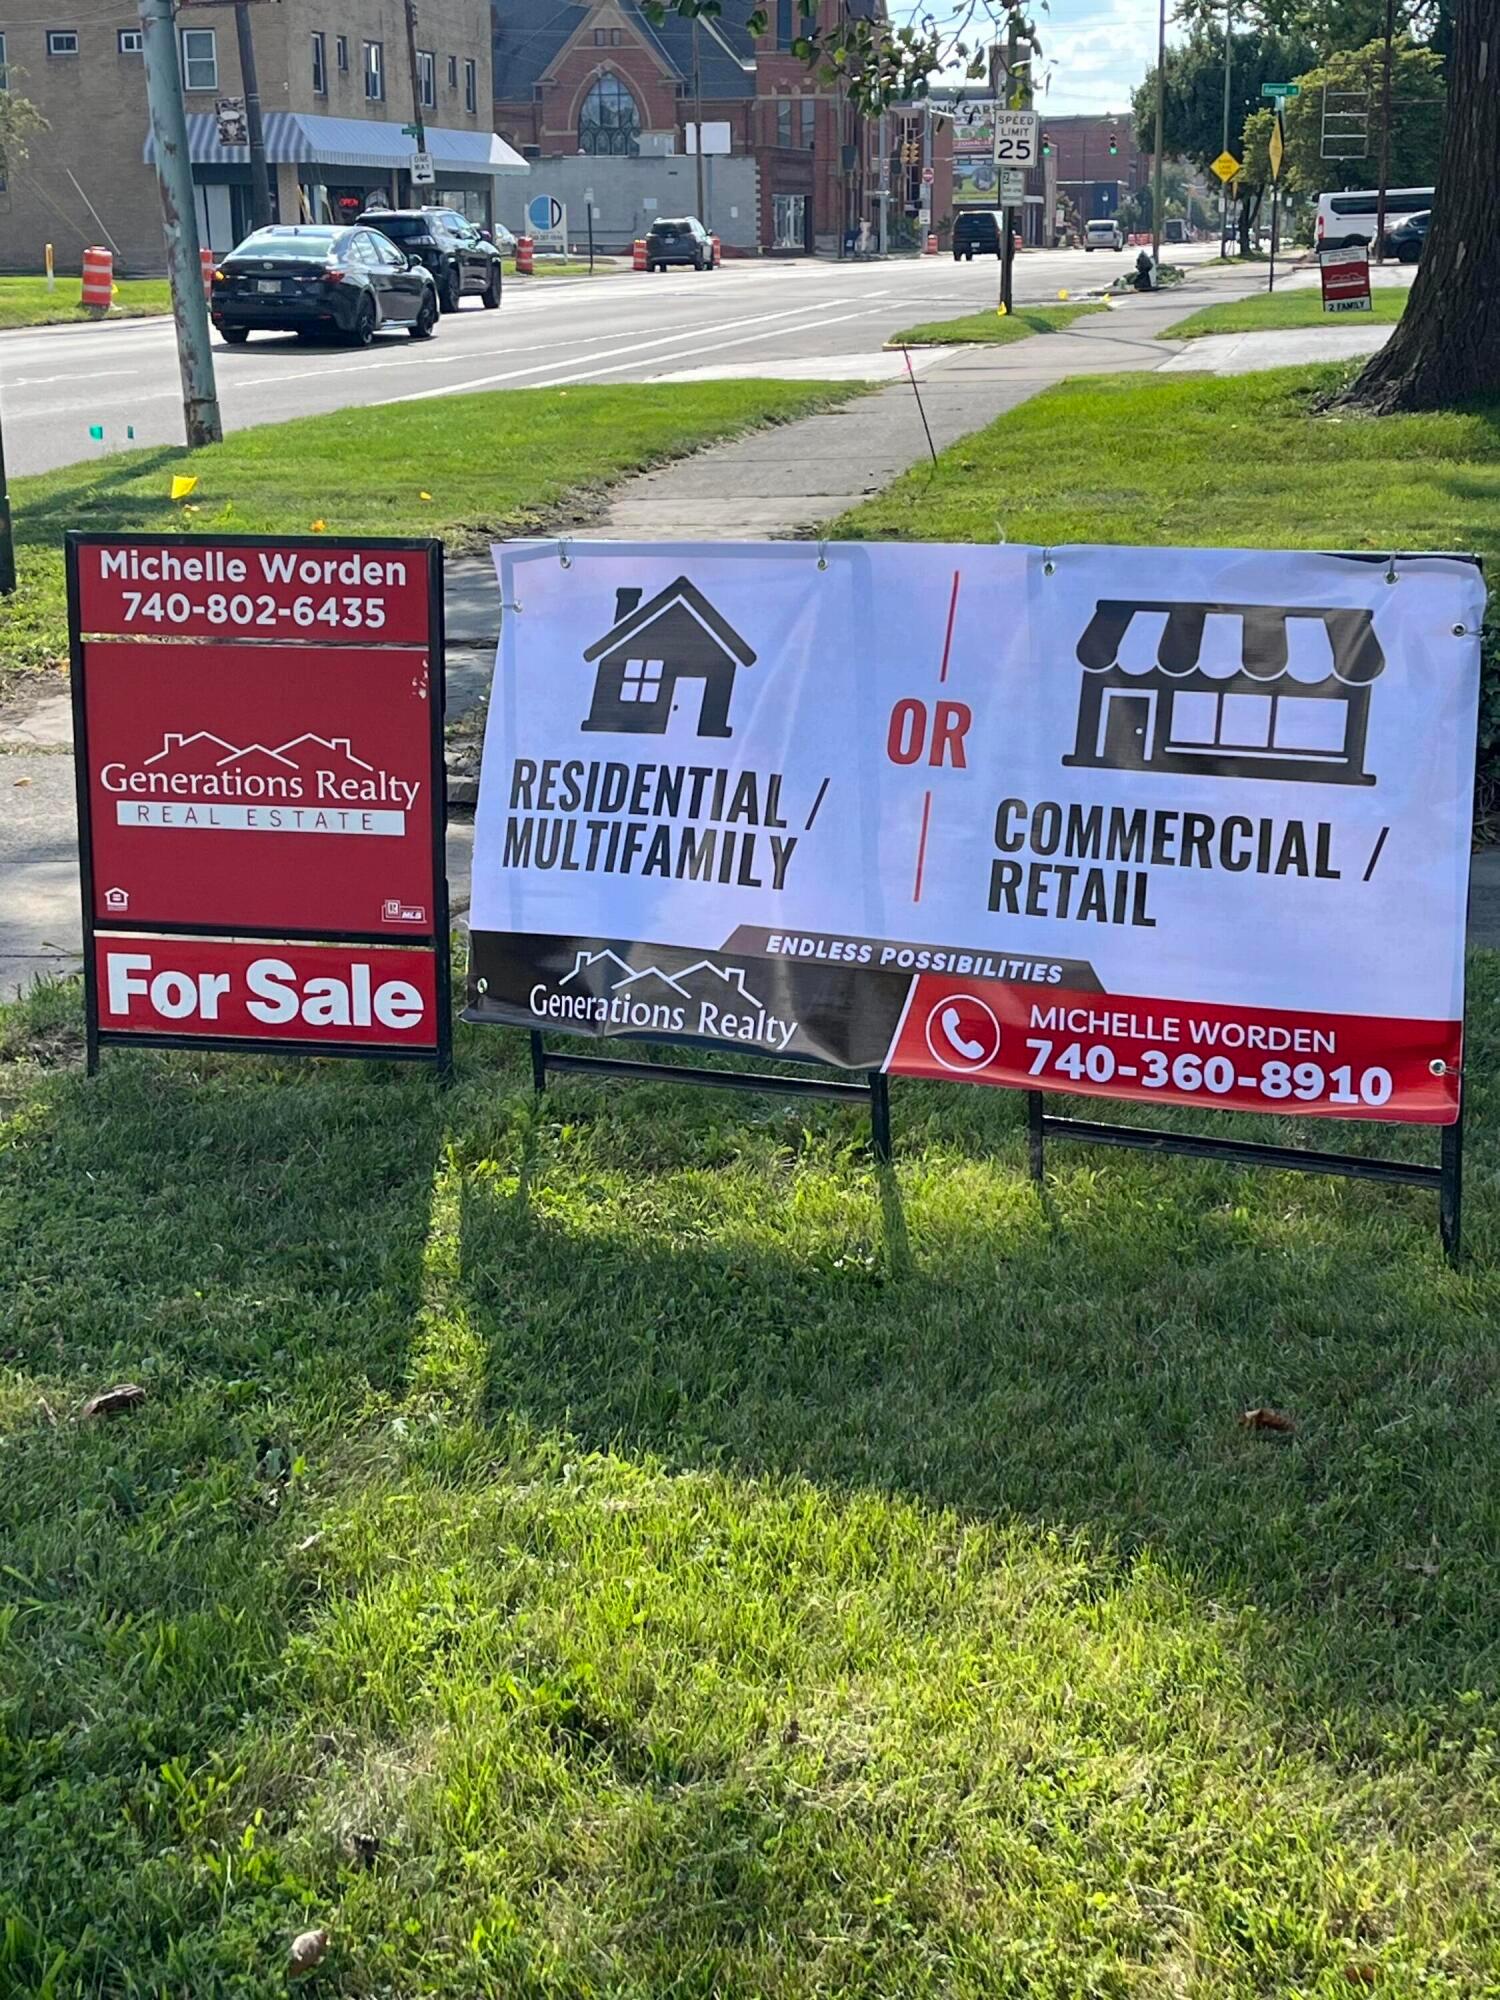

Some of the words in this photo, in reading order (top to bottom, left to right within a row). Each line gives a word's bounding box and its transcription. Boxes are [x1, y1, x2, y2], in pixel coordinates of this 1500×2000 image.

[998, 116, 1034, 126] SPEED
[1001, 128, 1029, 137] LIMIT
[998, 139, 1031, 160] 25
[1328, 303, 1335, 312] 2
[1337, 300, 1365, 312] FAMILY
[100, 550, 247, 583] Michelle
[259, 553, 406, 586] Worden
[122, 592, 386, 628] 740-802-6435
[888, 698, 972, 768] OR
[100, 763, 303, 798] Generations
[316, 770, 420, 810] Realty
[508, 758, 788, 829] RESIDENTIAL
[138, 805, 220, 825] REAL
[247, 809, 374, 831] ESTATE
[994, 798, 1341, 880] COMMERCIAL
[502, 816, 798, 890] MULTIFAMILY
[987, 859, 1157, 928] RETAIL
[766, 935, 872, 963] ENDLESS
[879, 947, 1063, 985] POSSIBILITIES
[106, 952, 231, 1020] For
[245, 958, 424, 1029] Sale
[530, 984, 685, 1032] Generations
[699, 1003, 798, 1050] Realty
[1029, 1004, 1181, 1043] MICHELLE
[1189, 1019, 1337, 1055] WORDEN
[1025, 1039, 1393, 1107] 740-360-8910
